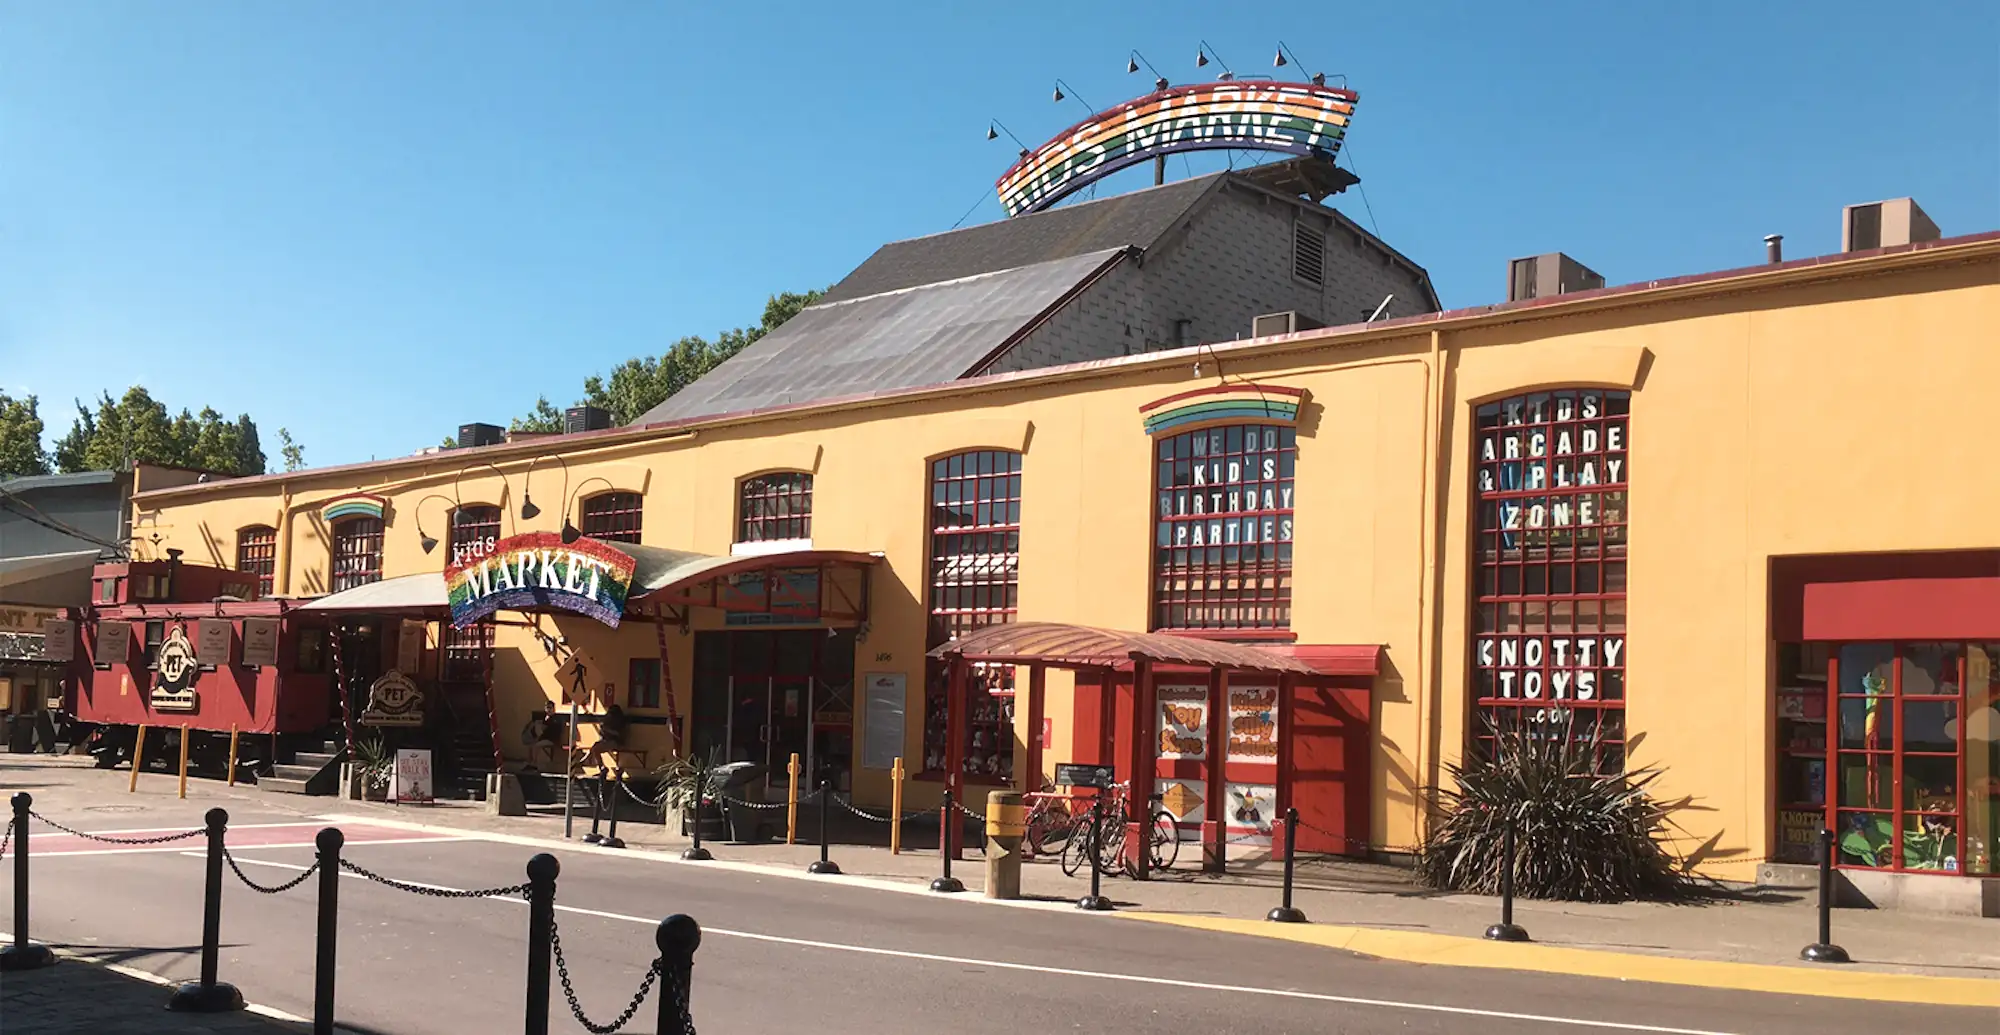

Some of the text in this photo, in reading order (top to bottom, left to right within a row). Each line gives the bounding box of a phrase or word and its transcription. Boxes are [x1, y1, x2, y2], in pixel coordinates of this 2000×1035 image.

[1000, 84, 1347, 216] KIDS MARKET
[1507, 395, 1597, 426] KIDS
[1193, 430, 1276, 456] WE DO
[1482, 427, 1621, 460] ARCADE
[1479, 460, 1622, 491] & PLAY
[1161, 488, 1293, 517] BIRTHDAY
[1506, 502, 1593, 529] ZONE
[1177, 520, 1293, 546] PARTIES
[453, 536, 496, 568] kids
[465, 549, 611, 605] MARKET
[167, 654, 182, 673] PET
[1477, 639, 1623, 667] KNOTTY
[384, 687, 406, 701] PET
[1500, 671, 1595, 700] TOYS
